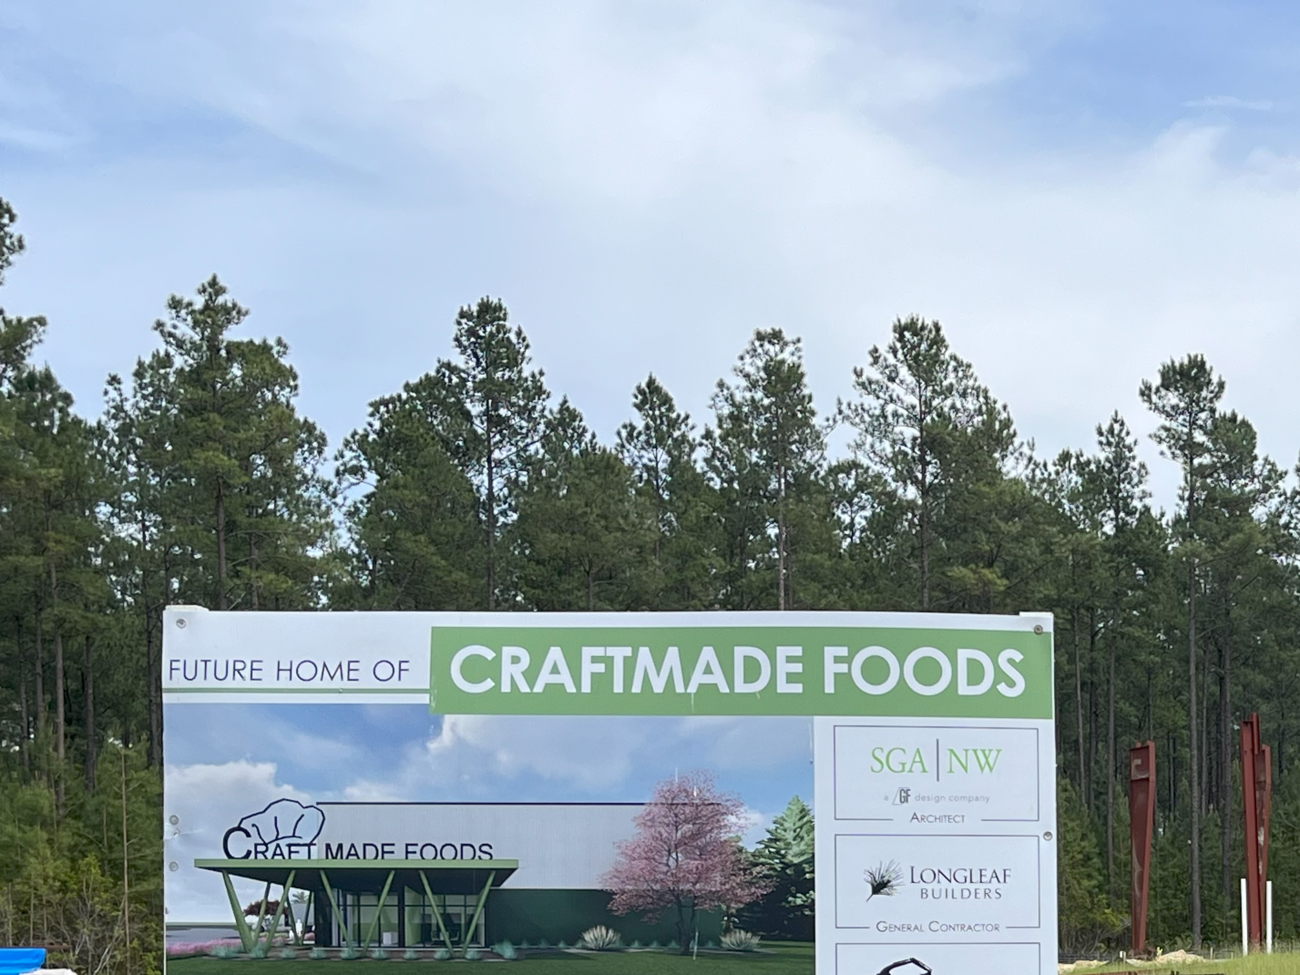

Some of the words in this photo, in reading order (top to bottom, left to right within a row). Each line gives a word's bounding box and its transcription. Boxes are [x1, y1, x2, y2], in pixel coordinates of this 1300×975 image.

[168, 659, 263, 681] FUTURE
[276, 659, 360, 682] HOME
[372, 659, 410, 682] OF
[450, 645, 803, 694] CRAFTMADE
[824, 646, 1026, 697] FOODS
[914, 793, 946, 804] design
[948, 795, 990, 804] company
[909, 811, 965, 824] ARCHITECT
[222, 826, 317, 860] CRAFT
[325, 843, 395, 860] MADE
[404, 843, 493, 860] FOODS
[909, 865, 1012, 884] LONGLEAF
[920, 887, 1003, 900] BUILDERS
[875, 920, 925, 933] GENERAL
[928, 920, 1000, 933] CONTRACTOR
